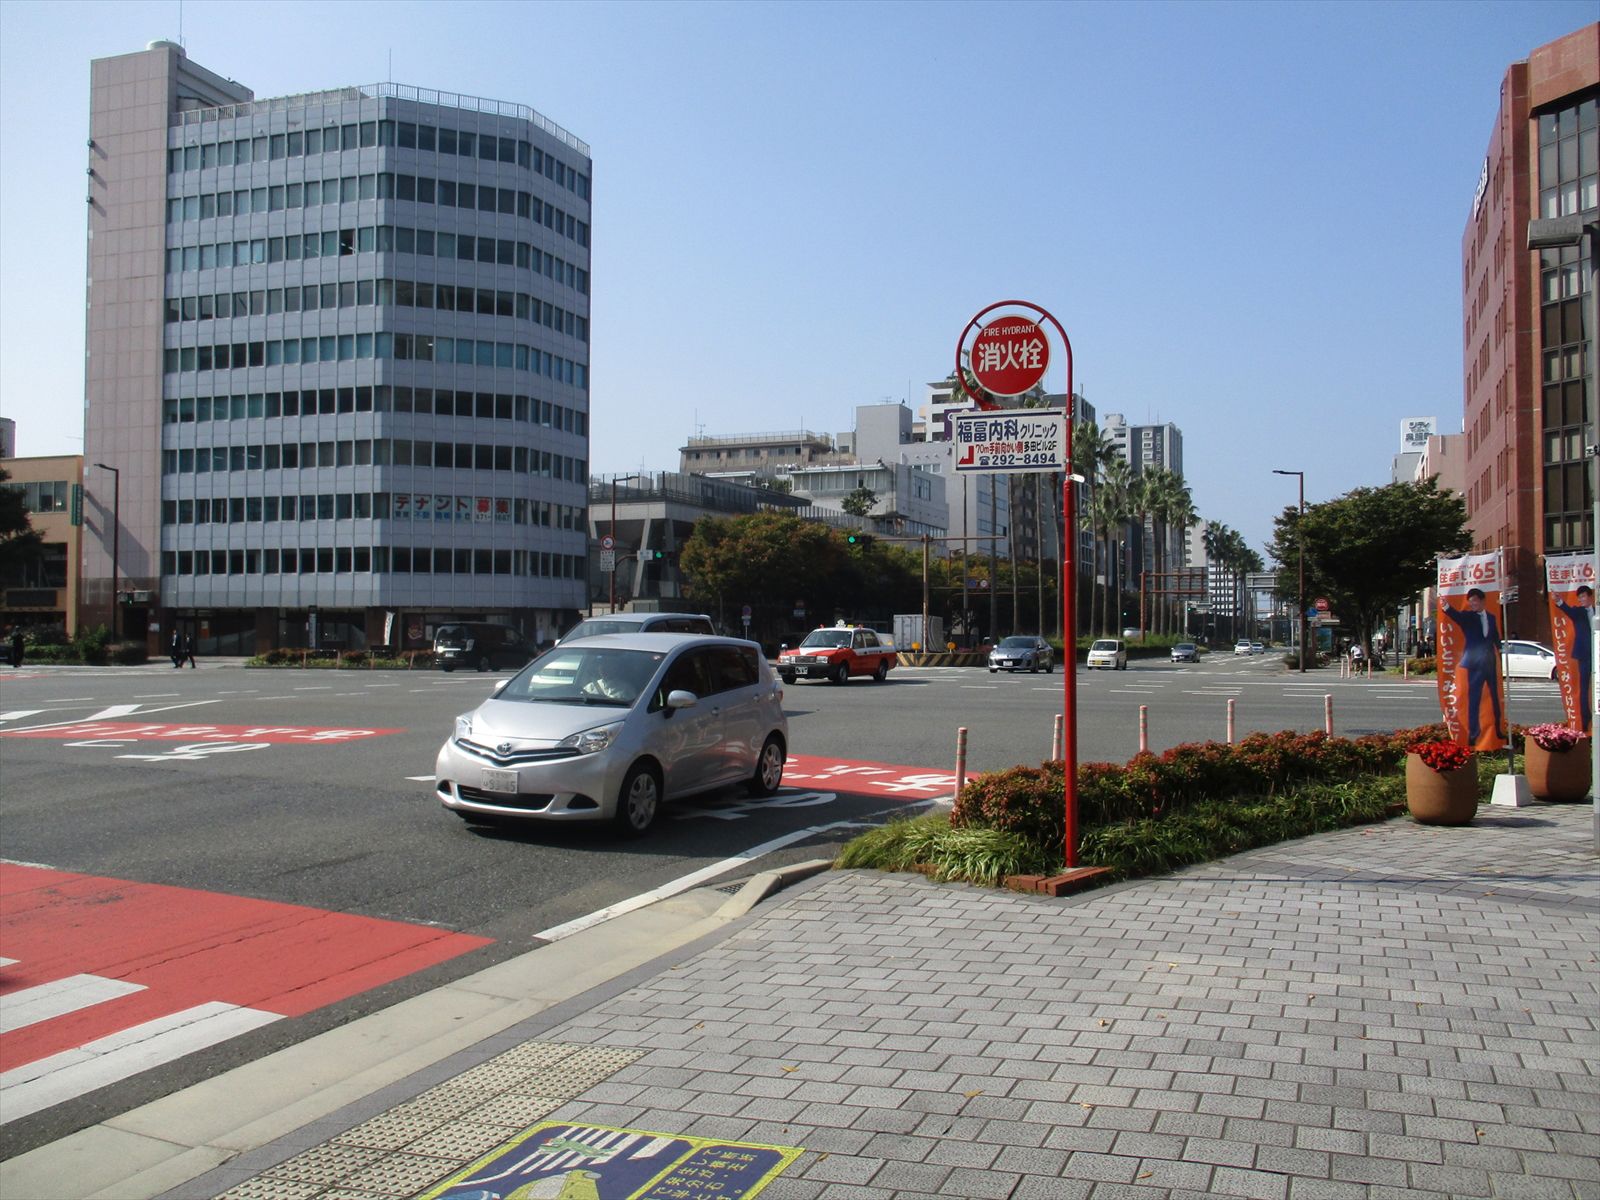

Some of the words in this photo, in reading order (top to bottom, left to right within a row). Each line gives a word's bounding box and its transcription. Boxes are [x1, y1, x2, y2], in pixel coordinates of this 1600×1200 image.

[983, 328, 1000, 337] FIRE
[1002, 324, 1036, 335] HYDRANT
[978, 338, 1043, 373] 消火栓
[991, 453, 1056, 466] 292-8494
[1549, 563, 1596, 580] 住まい6
